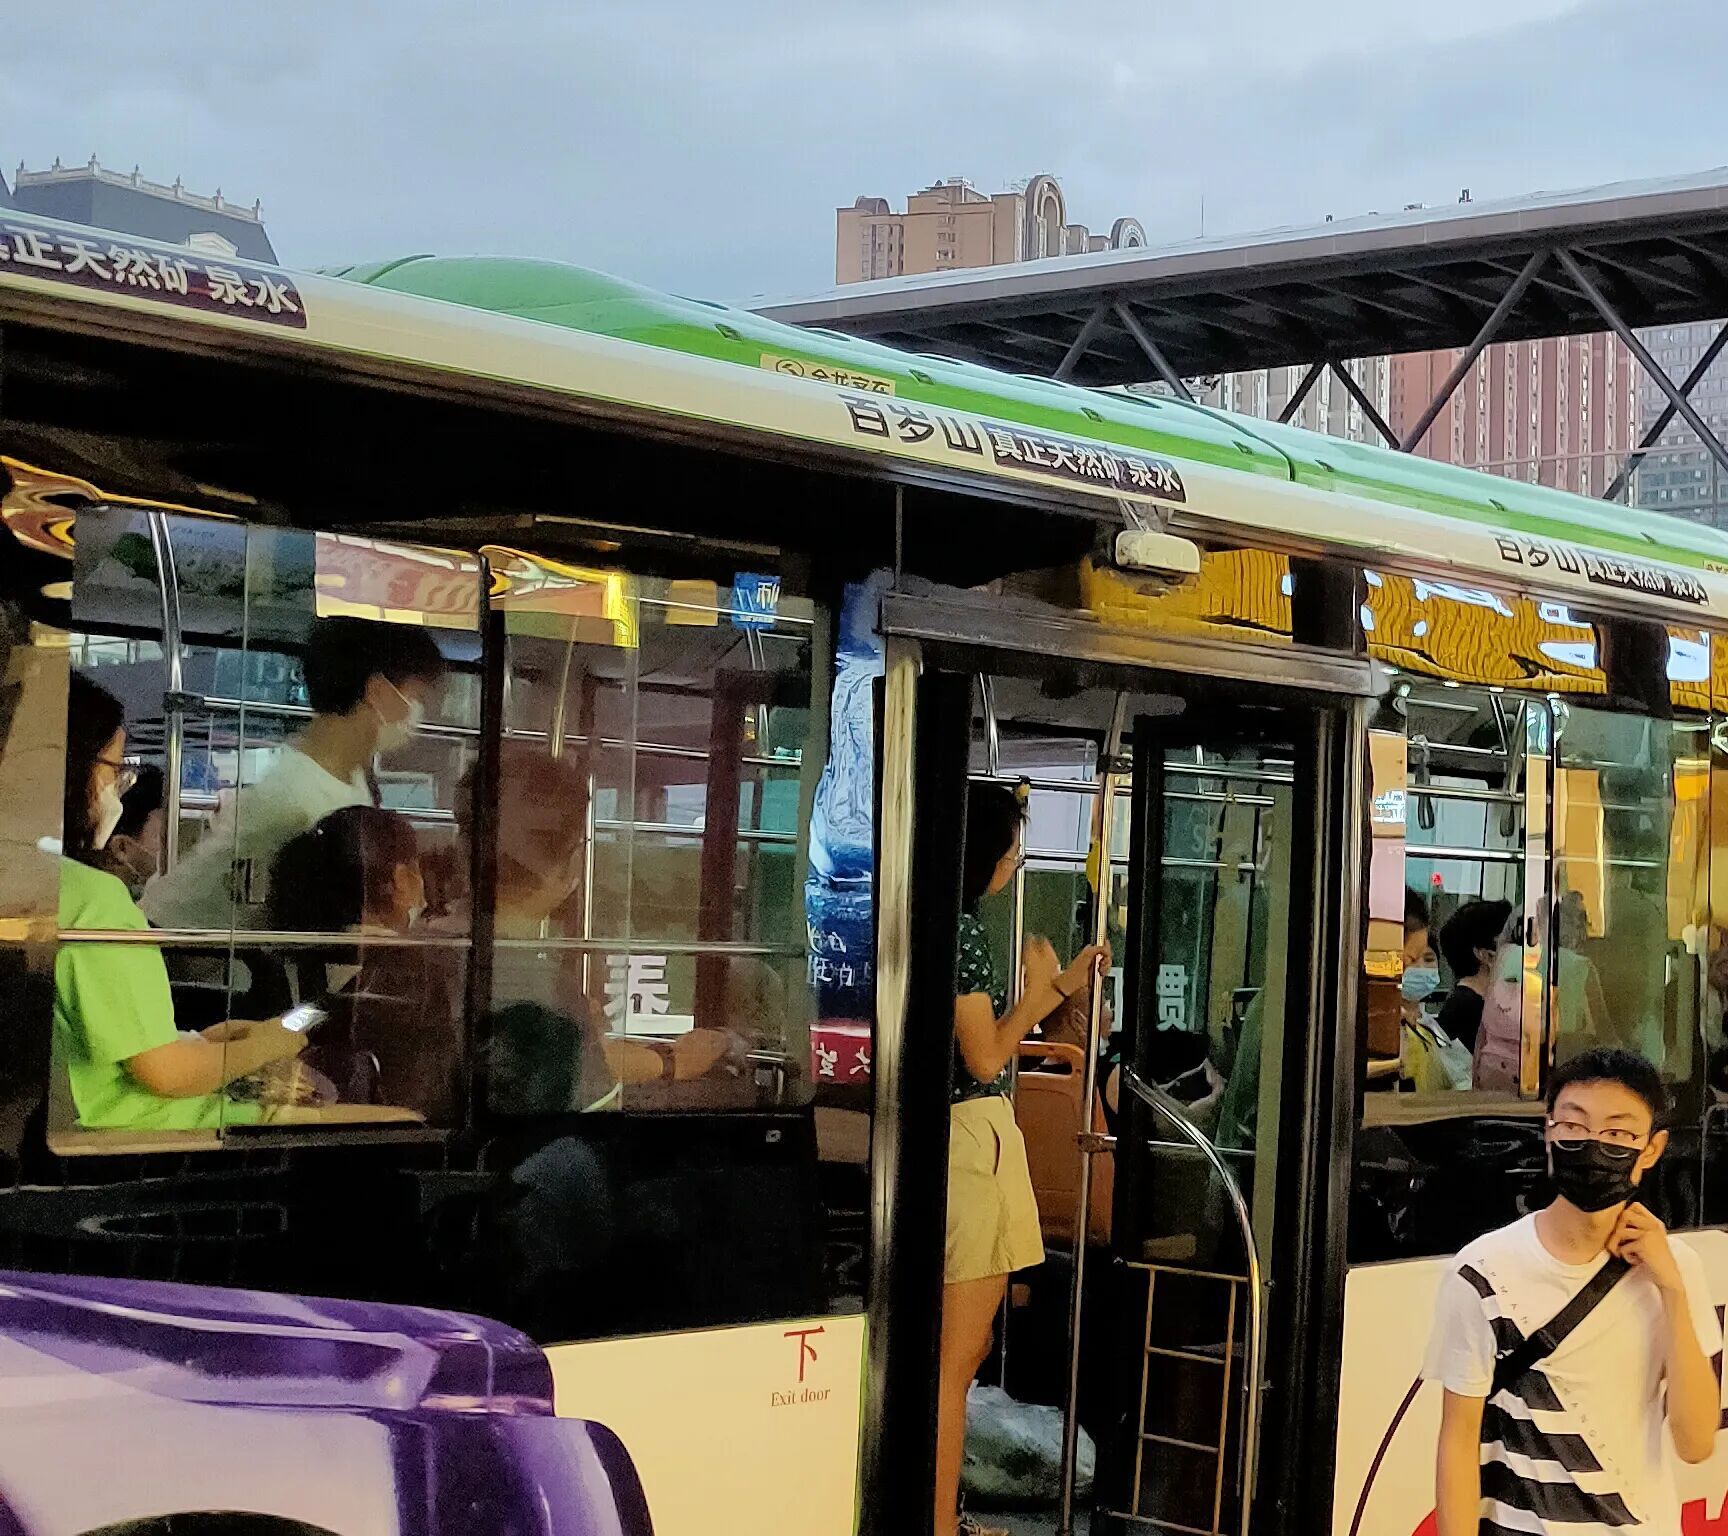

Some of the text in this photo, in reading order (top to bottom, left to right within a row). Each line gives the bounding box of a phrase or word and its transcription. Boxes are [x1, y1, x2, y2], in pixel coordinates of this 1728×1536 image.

[0, 224, 303, 314] 正天然矿泉水
[838, 393, 1182, 493] 百岁山 真正天然矿泉水
[783, 1325, 825, 1383] 下
[771, 1388, 831, 1407] Exit door
